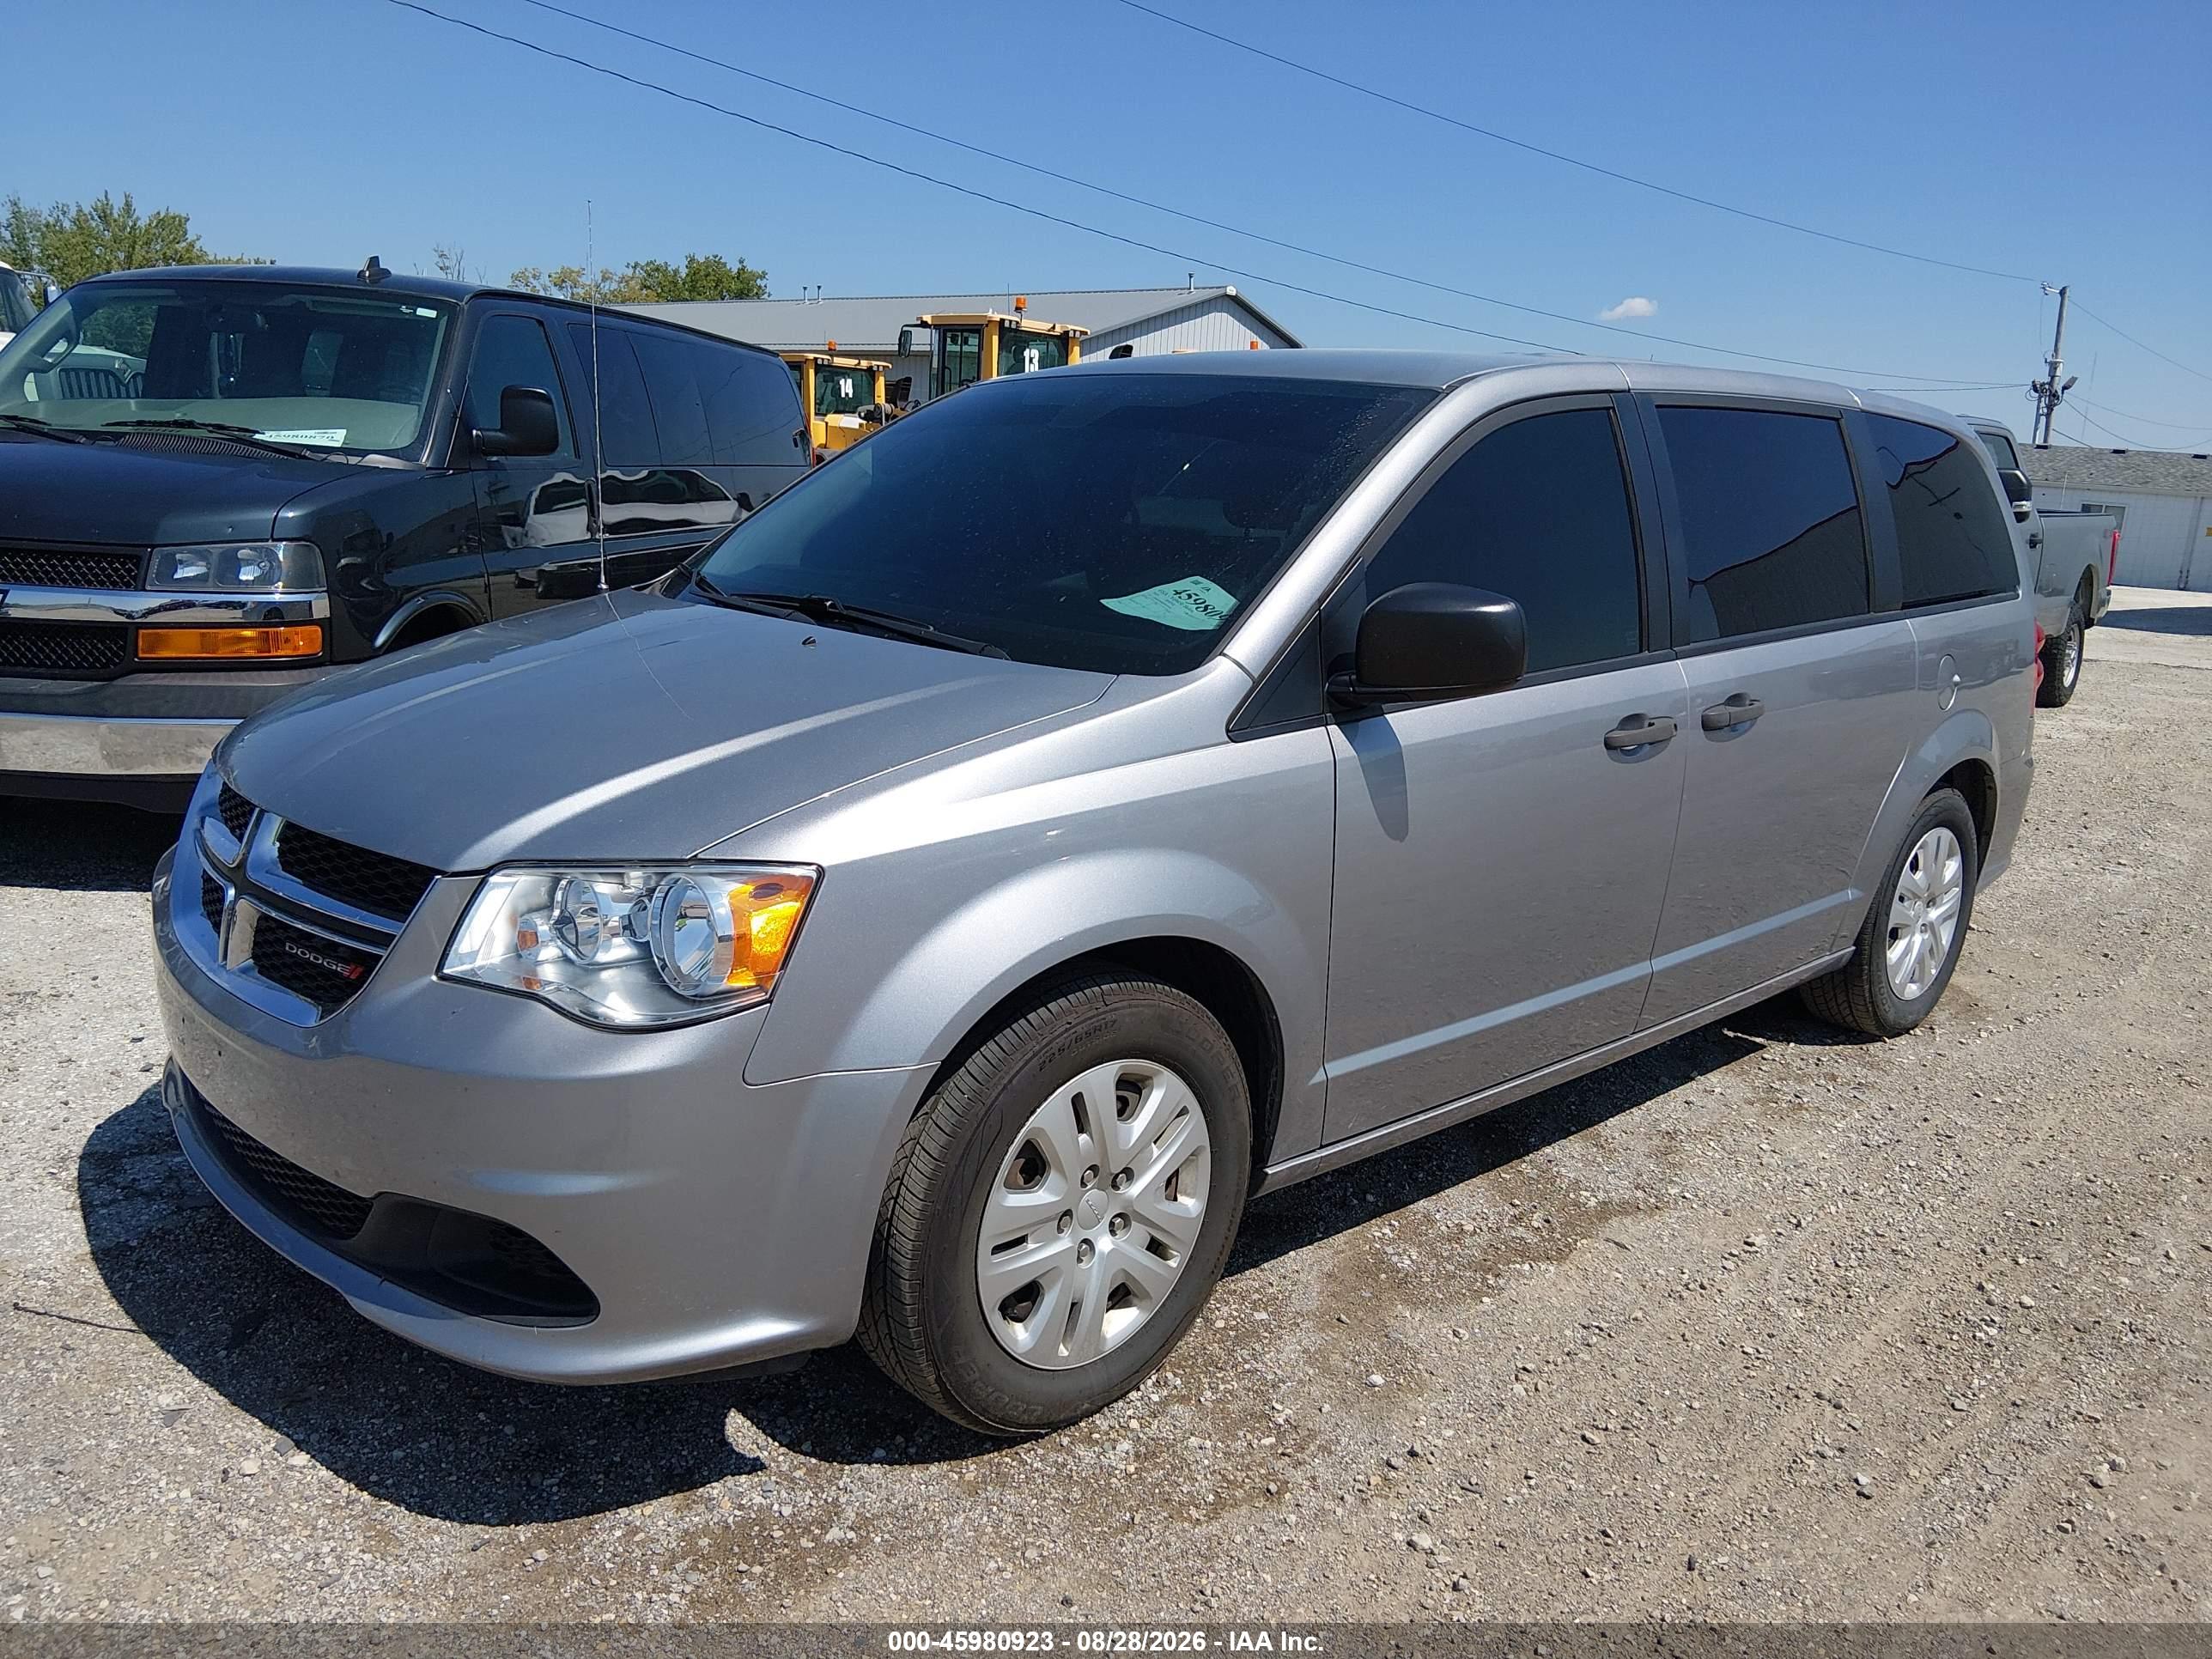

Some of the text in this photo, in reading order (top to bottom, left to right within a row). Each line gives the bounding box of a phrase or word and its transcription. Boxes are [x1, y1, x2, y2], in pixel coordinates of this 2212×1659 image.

[1023, 349, 1039, 373] 13
[839, 378, 854, 398] 14
[285, 942, 351, 977] DODGE
